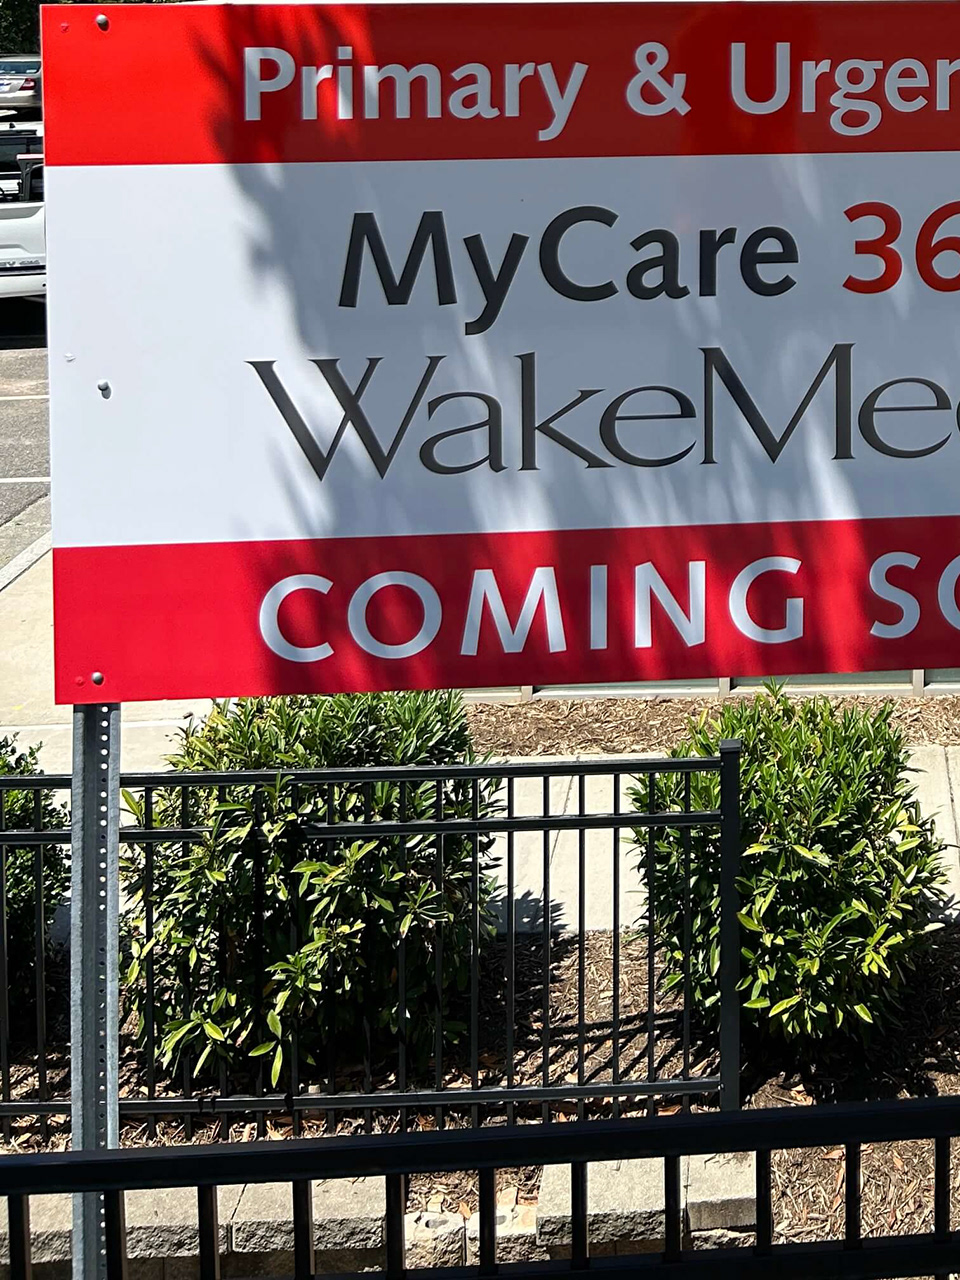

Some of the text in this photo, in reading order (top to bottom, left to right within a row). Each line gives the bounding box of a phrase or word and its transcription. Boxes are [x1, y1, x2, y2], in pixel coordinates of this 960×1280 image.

[243, 46, 588, 141] Primary
[626, 42, 691, 116] &
[338, 206, 799, 336] MyCare
[258, 555, 804, 663] COMING
